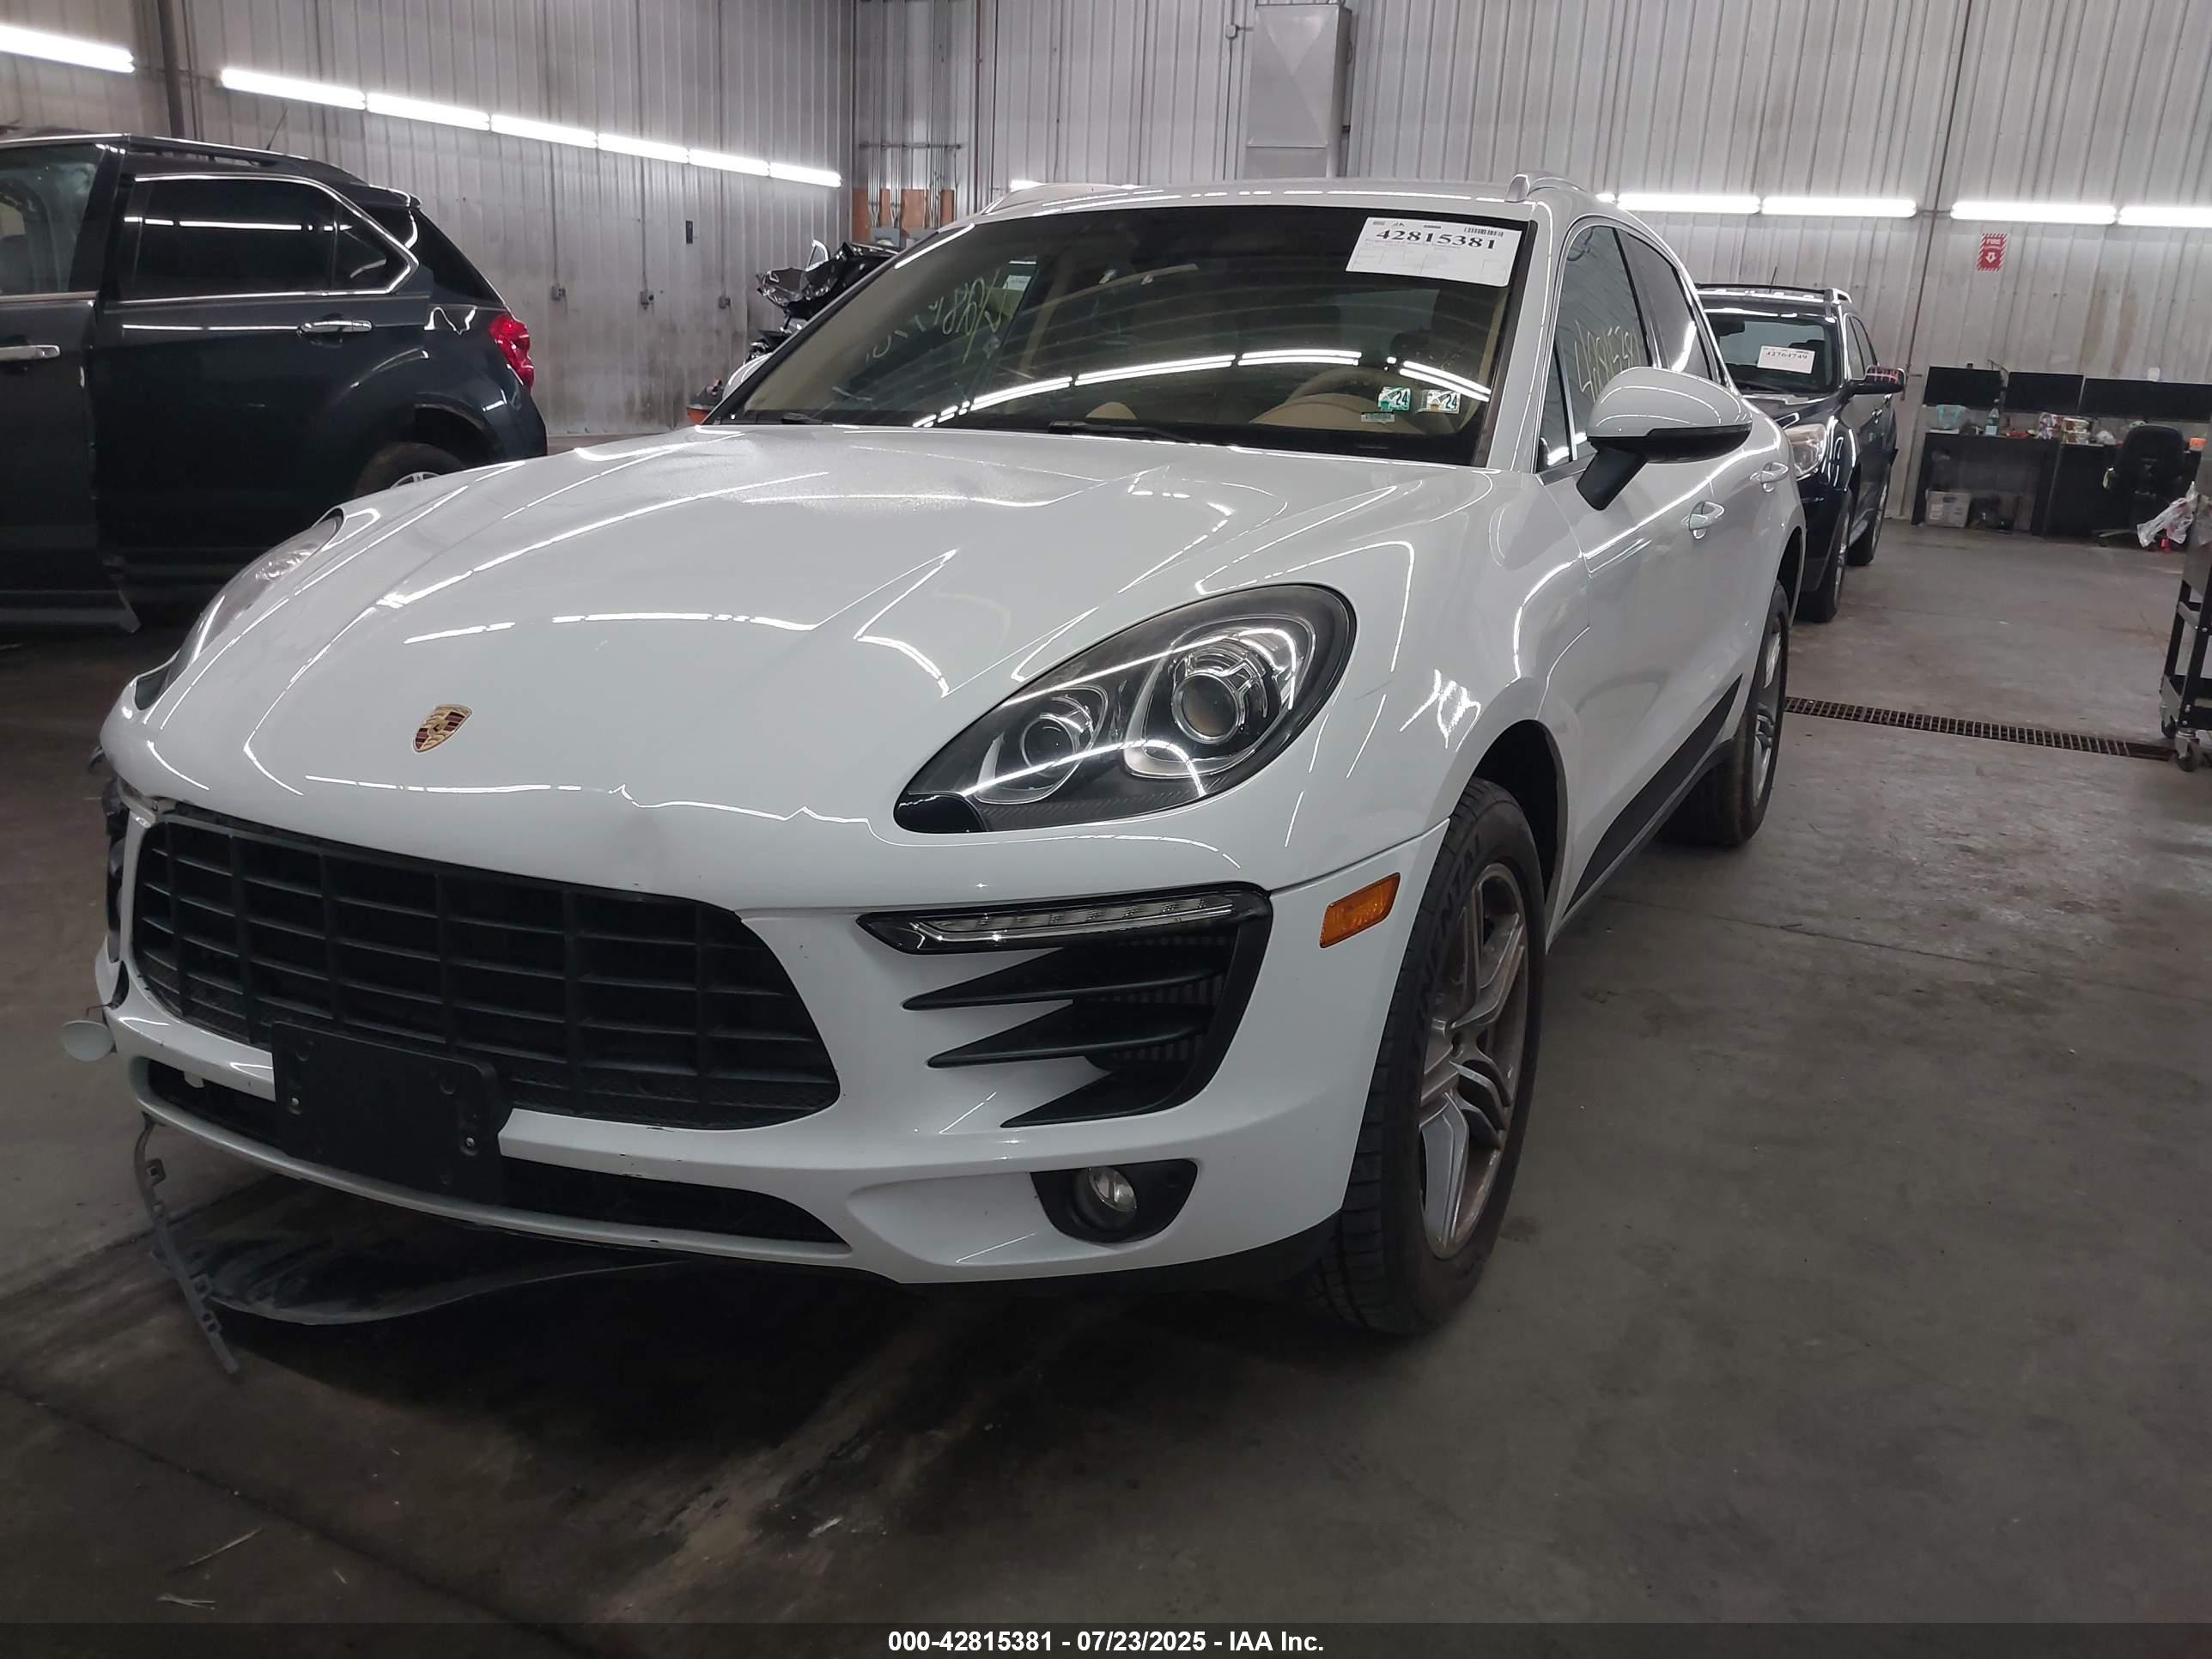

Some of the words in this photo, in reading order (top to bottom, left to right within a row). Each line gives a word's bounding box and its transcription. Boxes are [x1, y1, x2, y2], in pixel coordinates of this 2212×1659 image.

[1376, 228, 1497, 250] 42815381
[1395, 391, 1408, 405] 24
[1445, 394, 1457, 410] 24
